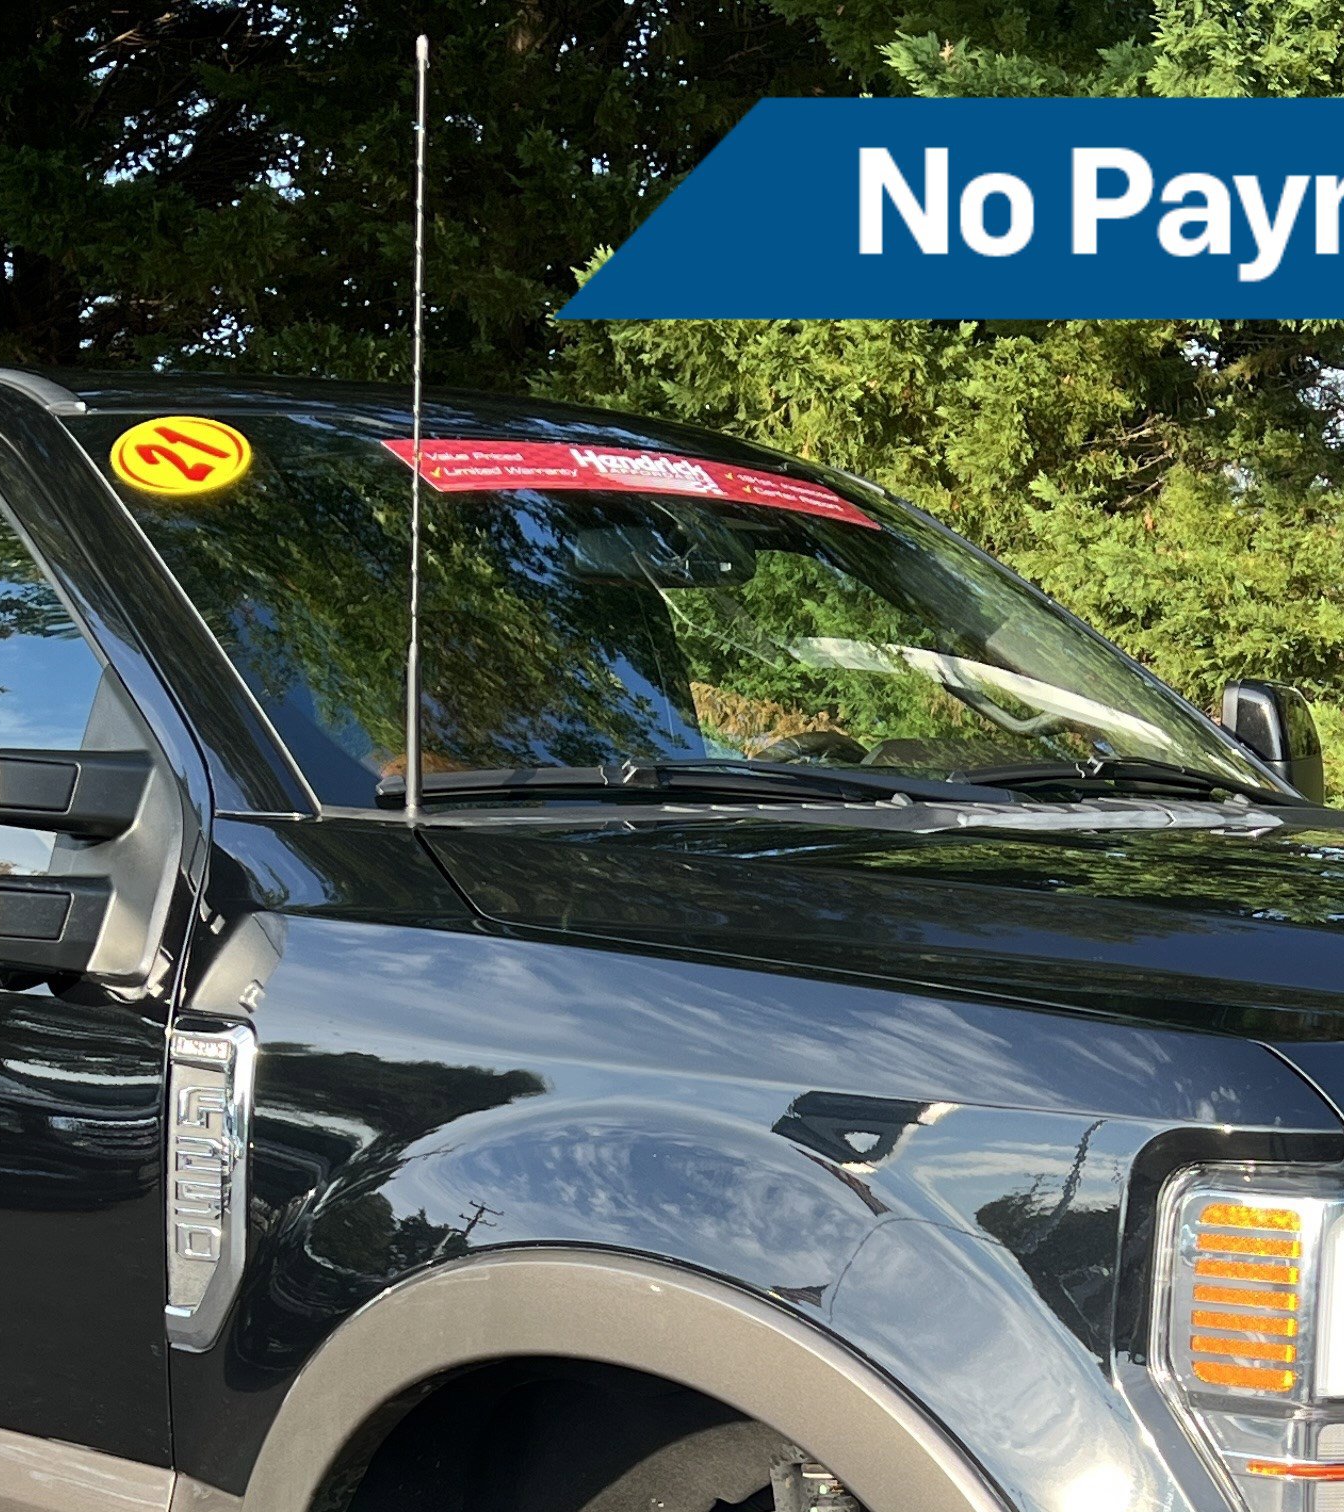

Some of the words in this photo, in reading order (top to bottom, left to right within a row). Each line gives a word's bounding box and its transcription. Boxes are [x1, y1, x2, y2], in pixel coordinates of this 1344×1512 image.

[135, 426, 231, 481] 21
[426, 451, 470, 462] Value
[444, 466, 503, 476] Limited
[505, 466, 578, 478] Warranty
[570, 448, 719, 489] Hendrick
